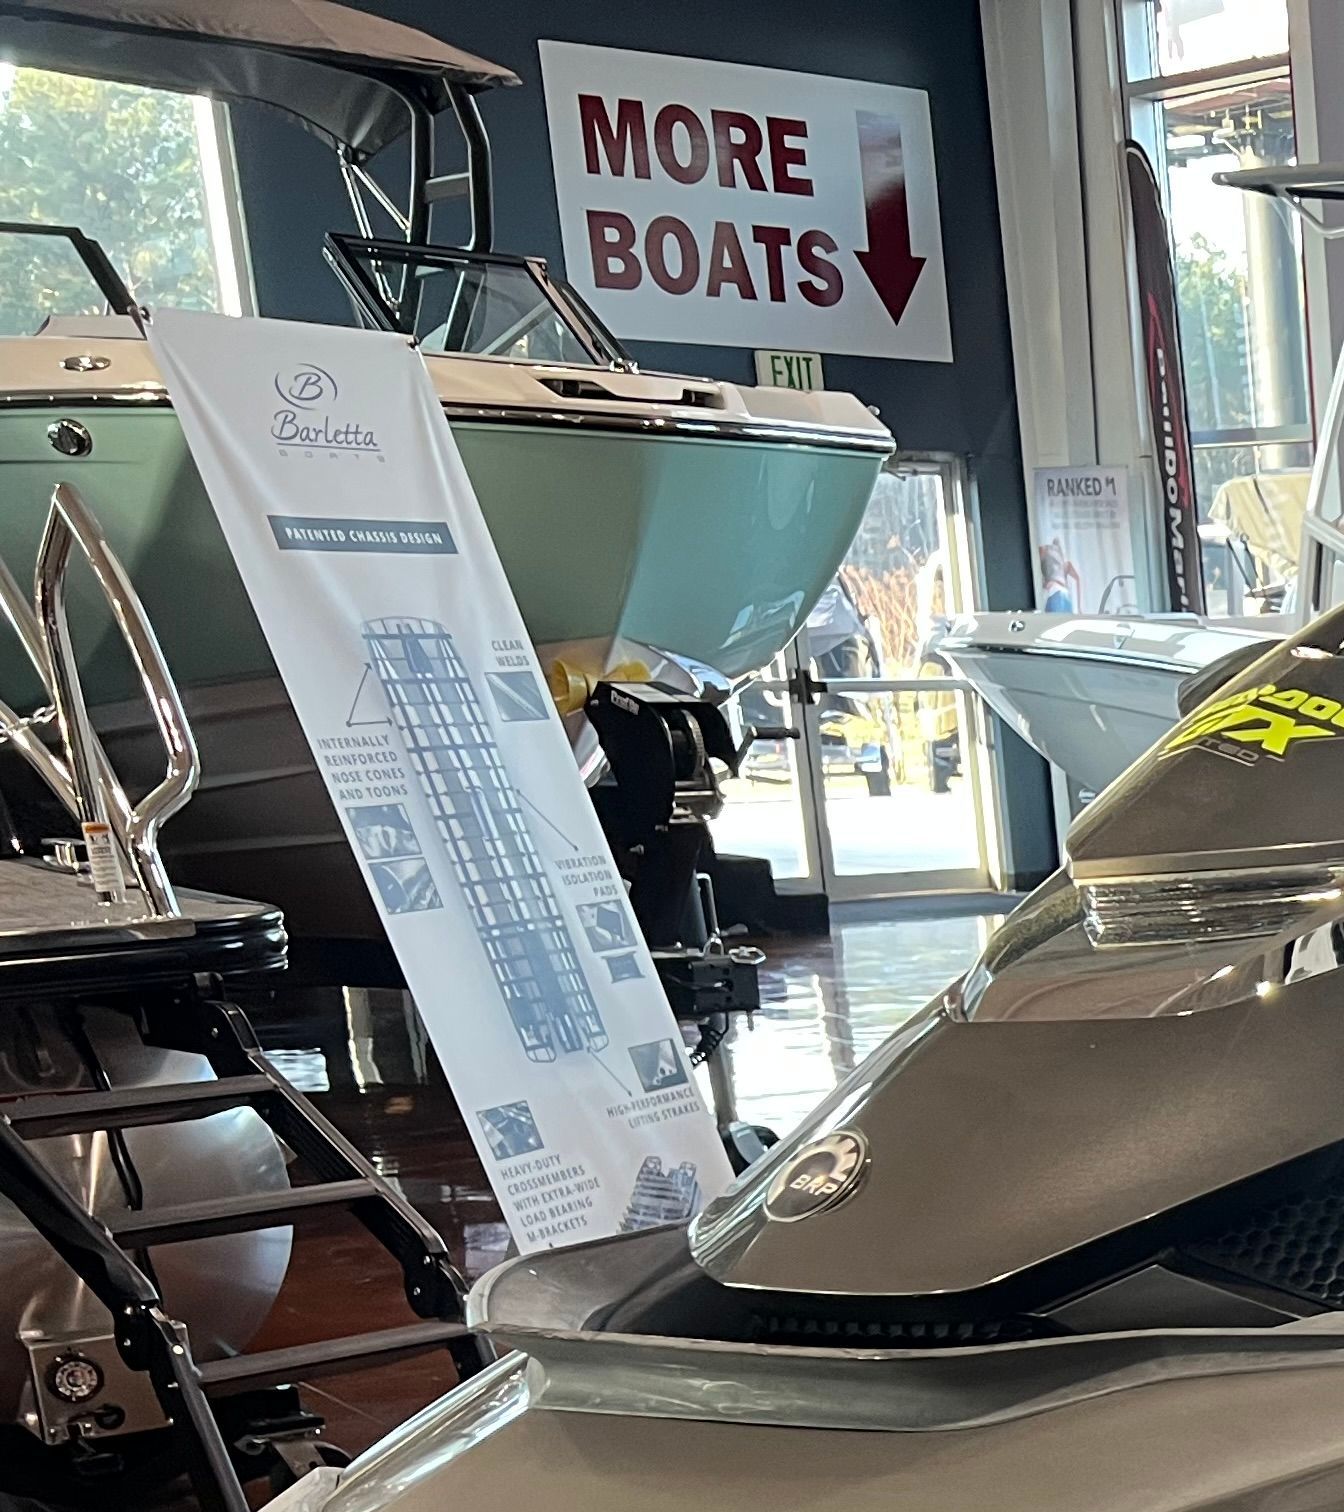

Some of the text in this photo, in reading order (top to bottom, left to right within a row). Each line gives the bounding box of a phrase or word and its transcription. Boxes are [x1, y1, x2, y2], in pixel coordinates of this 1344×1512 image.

[578, 93, 815, 197] MORE
[586, 209, 844, 308] BOATS
[770, 355, 813, 390] EXIT
[270, 409, 379, 447] Barletta
[1047, 478, 1102, 497] RANKED
[285, 527, 443, 545] PATENTED CHASSIS DESIGN
[491, 639, 524, 651] CLEAN
[496, 655, 530, 667] WELDS
[317, 734, 390, 749] INTERNALLY
[324, 751, 398, 766] REINFORCED
[331, 767, 405, 783] NOSE CONES
[339, 784, 408, 800] AND TOONS
[554, 855, 606, 870] VIBRATION
[561, 870, 613, 886] ISOLATION
[593, 884, 619, 896] PADS
[606, 1087, 695, 1118] HIGH-PERFORMANCE
[627, 1101, 700, 1129] LIFTING STRAKES
[500, 1154, 561, 1180] HEAVY-DUTY
[507, 1165, 586, 1196] CROSSMEMBERS
[789, 1174, 838, 1196] BRP
[513, 1177, 600, 1212] WITH EXTRA-WIDE
[520, 1196, 593, 1228] LOAD BEARING
[526, 1215, 588, 1242] M-BRACKETS
